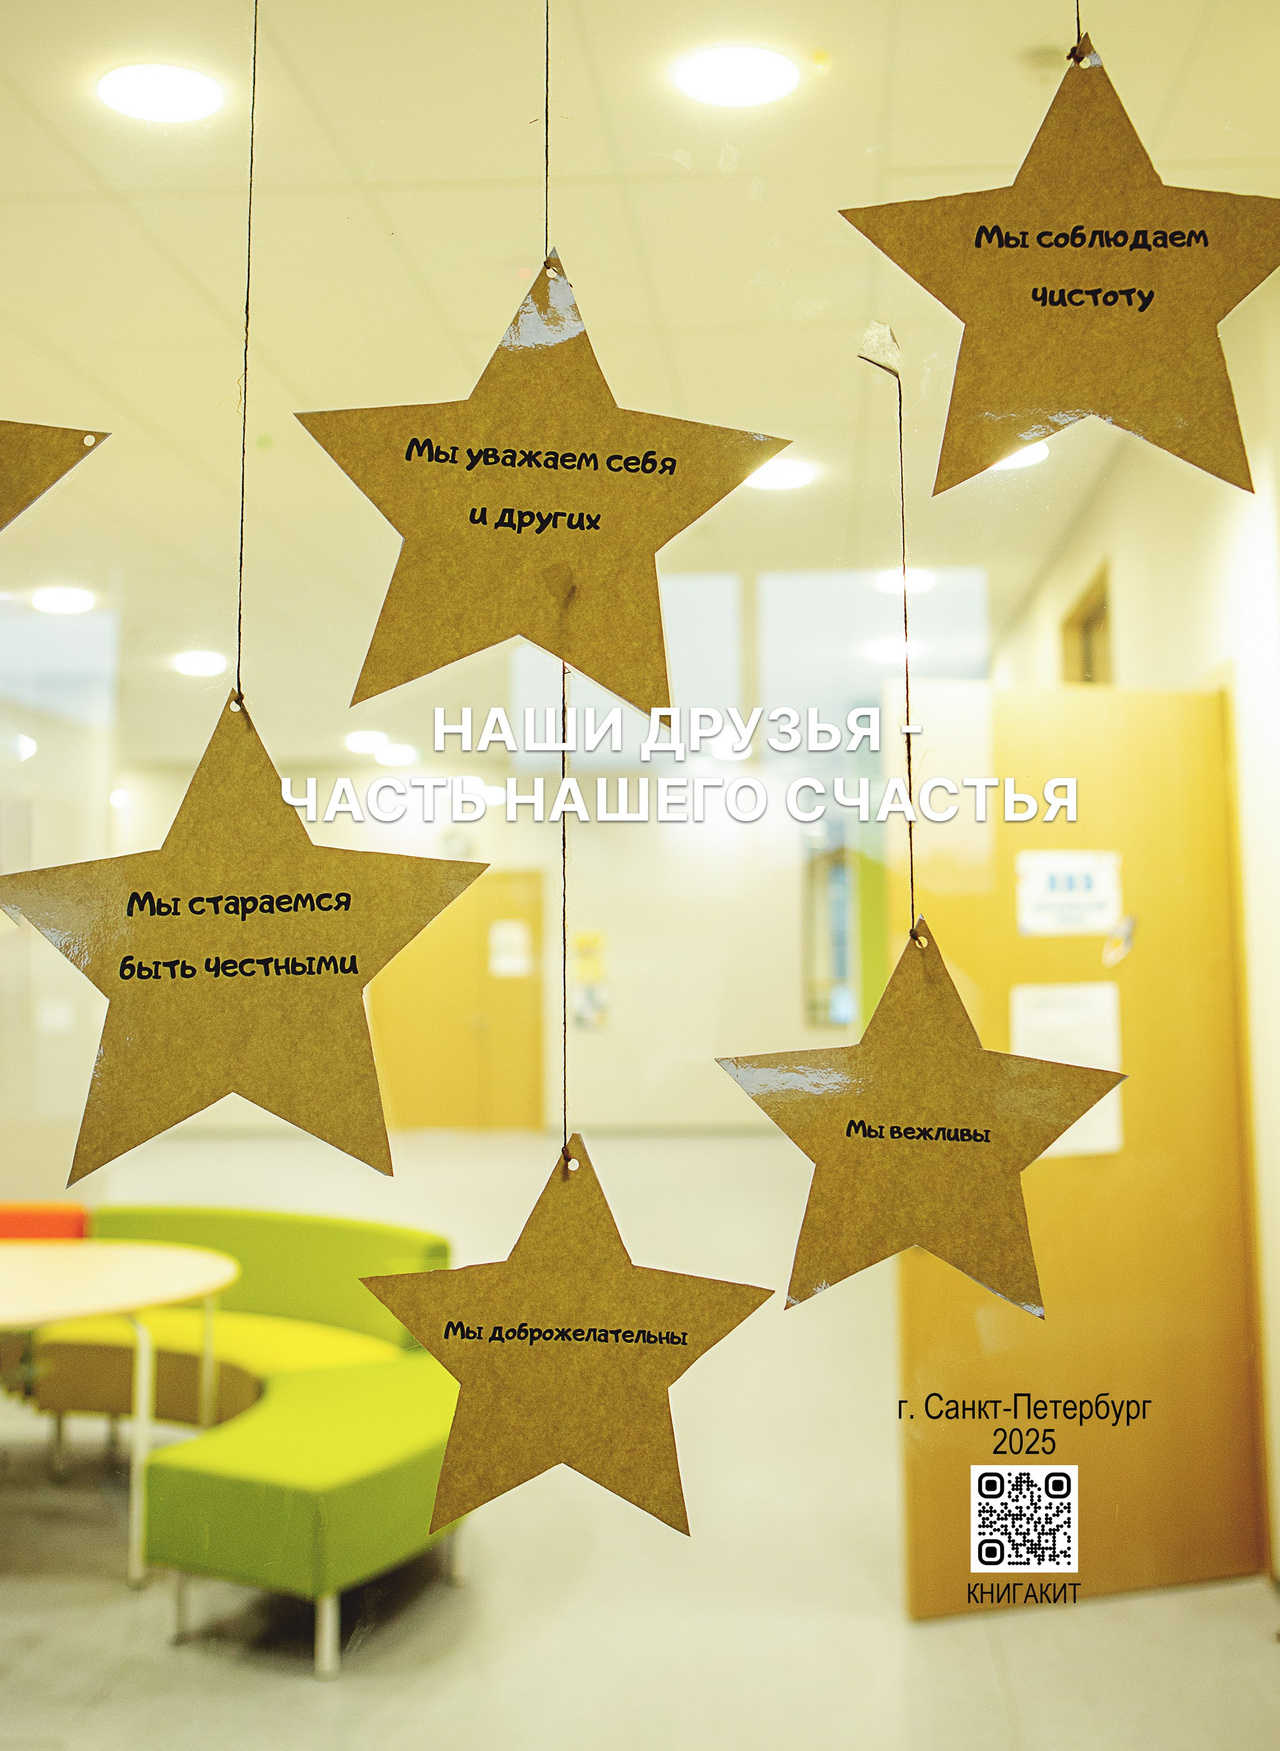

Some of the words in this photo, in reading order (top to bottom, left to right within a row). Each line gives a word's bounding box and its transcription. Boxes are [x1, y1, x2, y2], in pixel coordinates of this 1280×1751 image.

[974, 224, 1030, 249] Мы
[1036, 225, 1209, 252] соблюдаем
[1031, 286, 1155, 313] чистоту
[404, 437, 460, 465] Мы
[465, 447, 599, 472] уважаем
[605, 450, 678, 476] себя
[468, 506, 488, 526] и
[494, 507, 602, 535] других
[126, 890, 181, 917] Мы
[188, 892, 352, 922] стараемся
[119, 955, 198, 980] быть
[204, 954, 359, 978] честными
[845, 1119, 885, 1139] Мы
[889, 1125, 991, 1143] вежливы
[443, 1320, 484, 1341] Мы
[488, 1322, 689, 1346] доброжелательны
